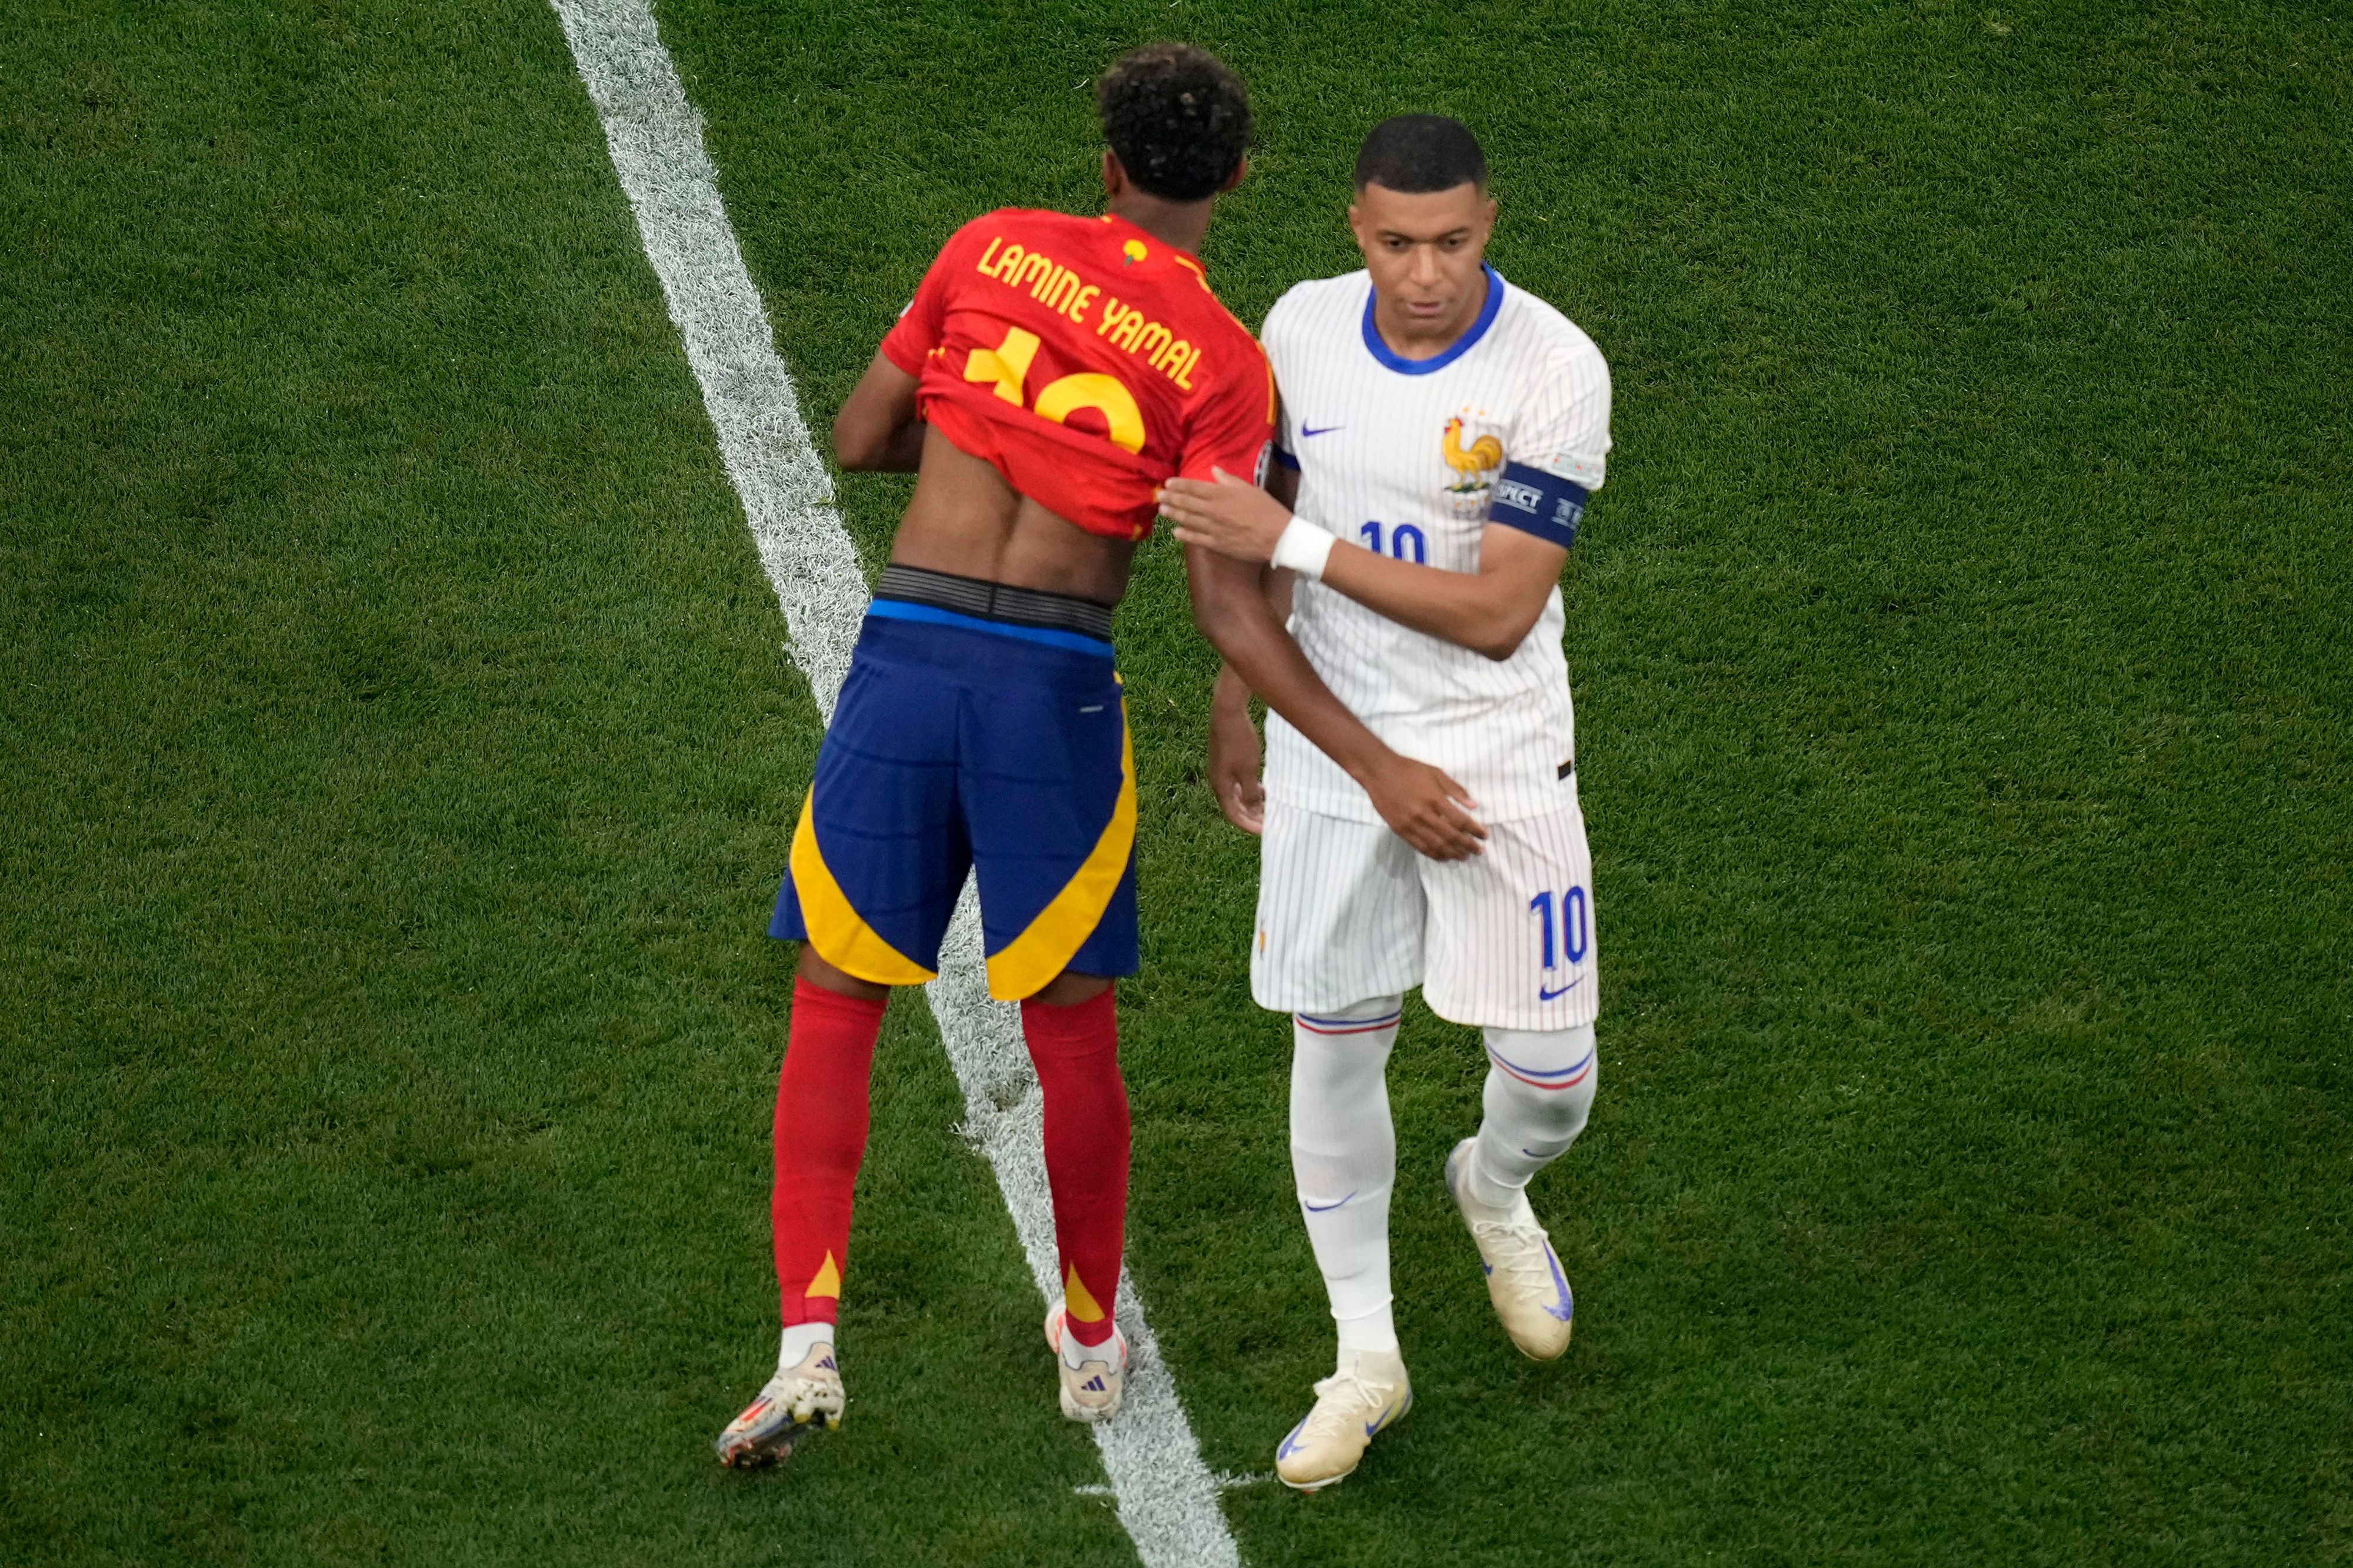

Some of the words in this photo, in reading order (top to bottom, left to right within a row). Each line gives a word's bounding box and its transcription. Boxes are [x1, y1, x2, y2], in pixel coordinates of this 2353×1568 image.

[976, 236, 1101, 324] LAMINE
[1096, 297, 1201, 391] YAMAL
[1531, 886, 1587, 969] 10
